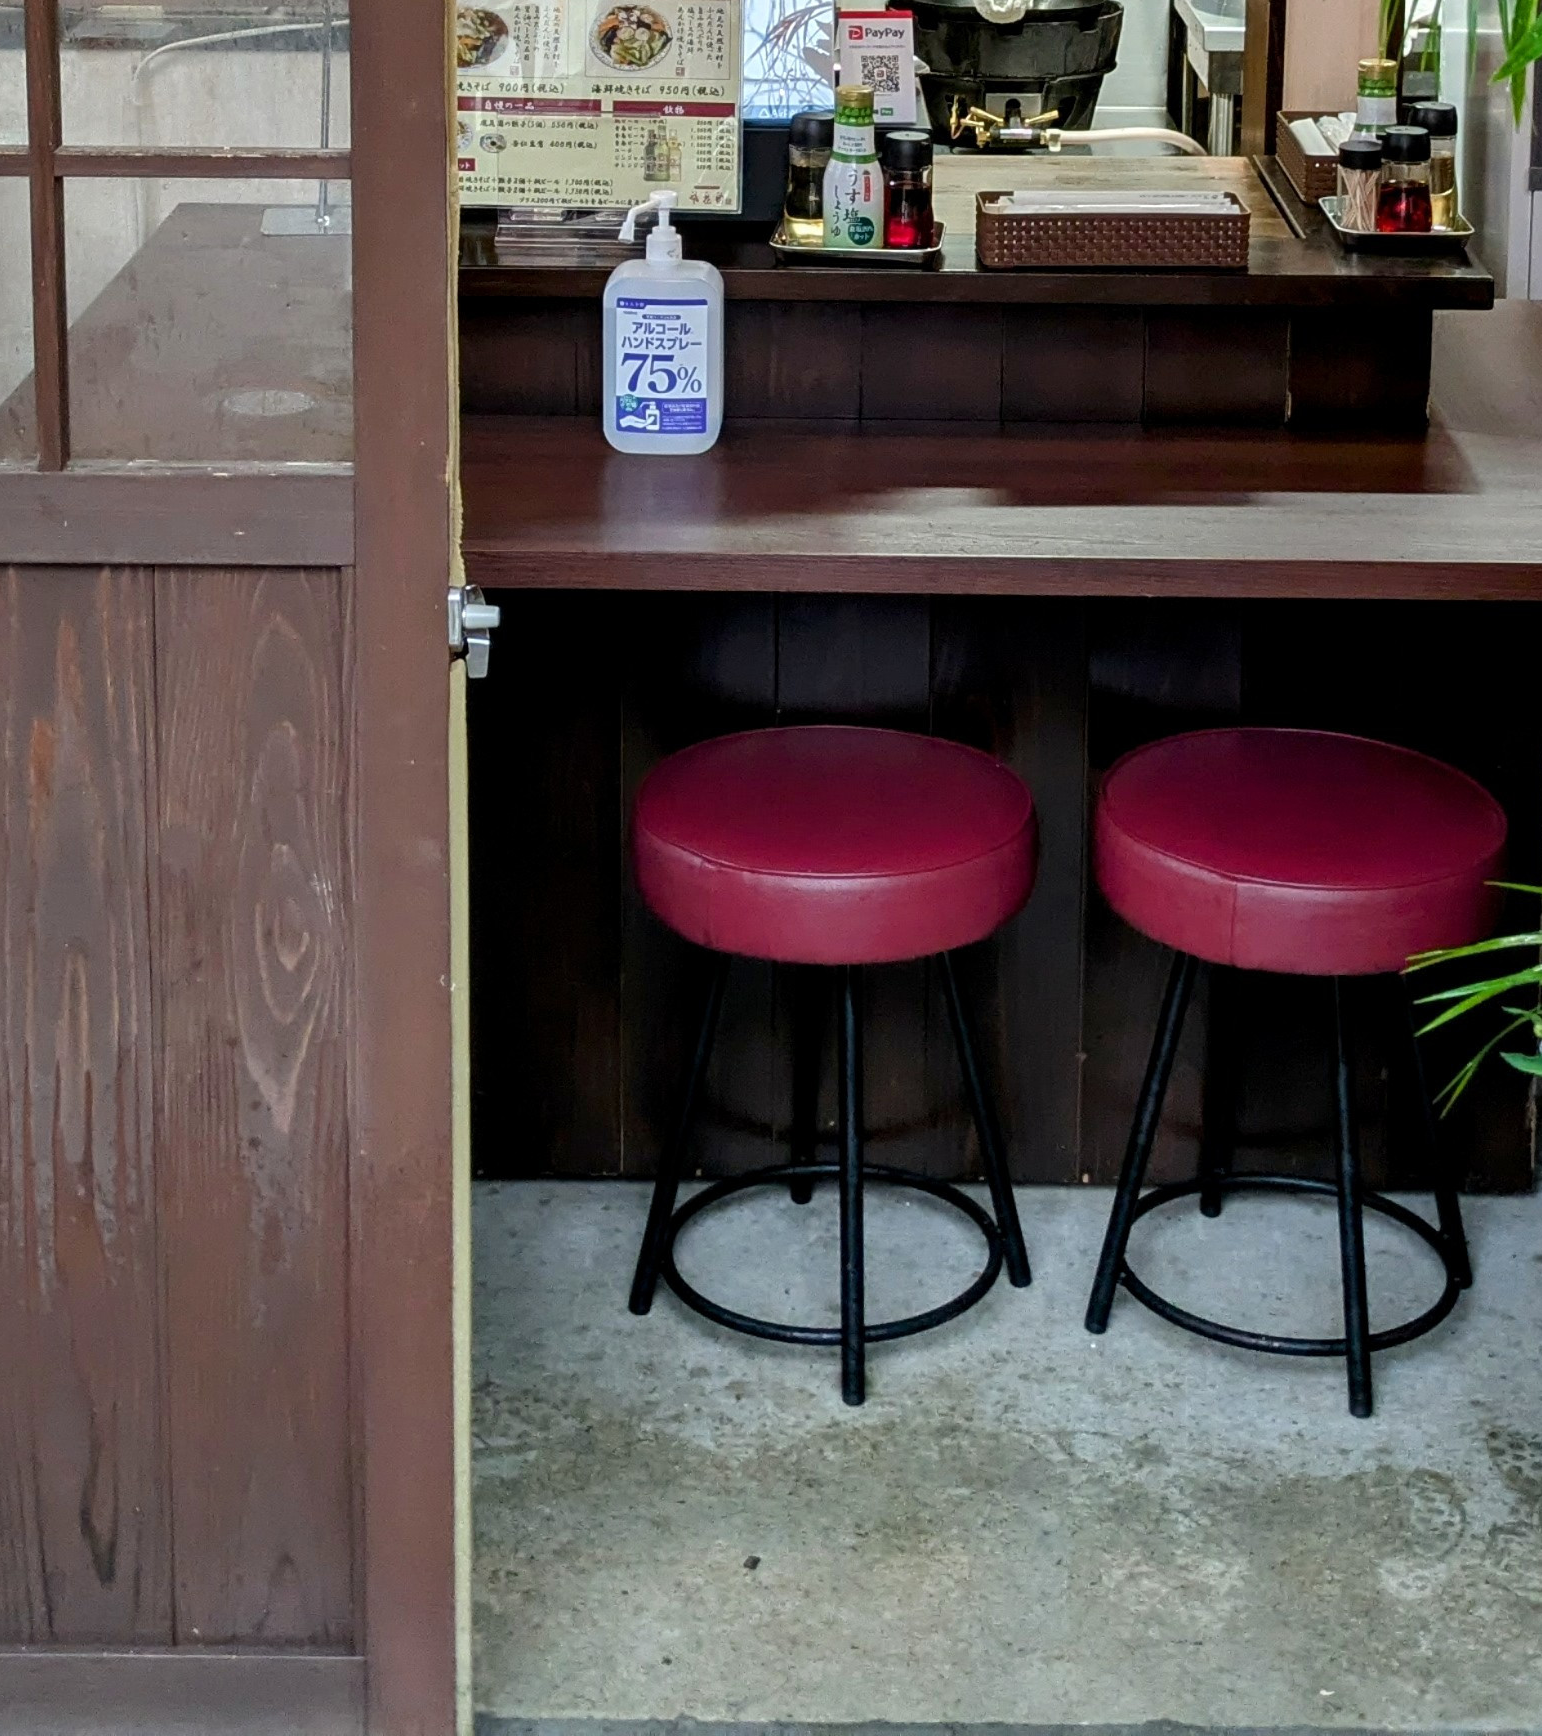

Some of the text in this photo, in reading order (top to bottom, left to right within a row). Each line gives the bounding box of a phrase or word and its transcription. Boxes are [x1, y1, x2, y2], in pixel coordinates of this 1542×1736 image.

[864, 26, 905, 40] PayPay
[659, 85, 725, 98] 950円(税込)
[843, 169, 861, 223] うす塩
[830, 184, 842, 238] しょうゆ
[631, 321, 692, 336] アルコール
[621, 336, 703, 351] ハンドスプレー
[620, 352, 703, 394] 75%
